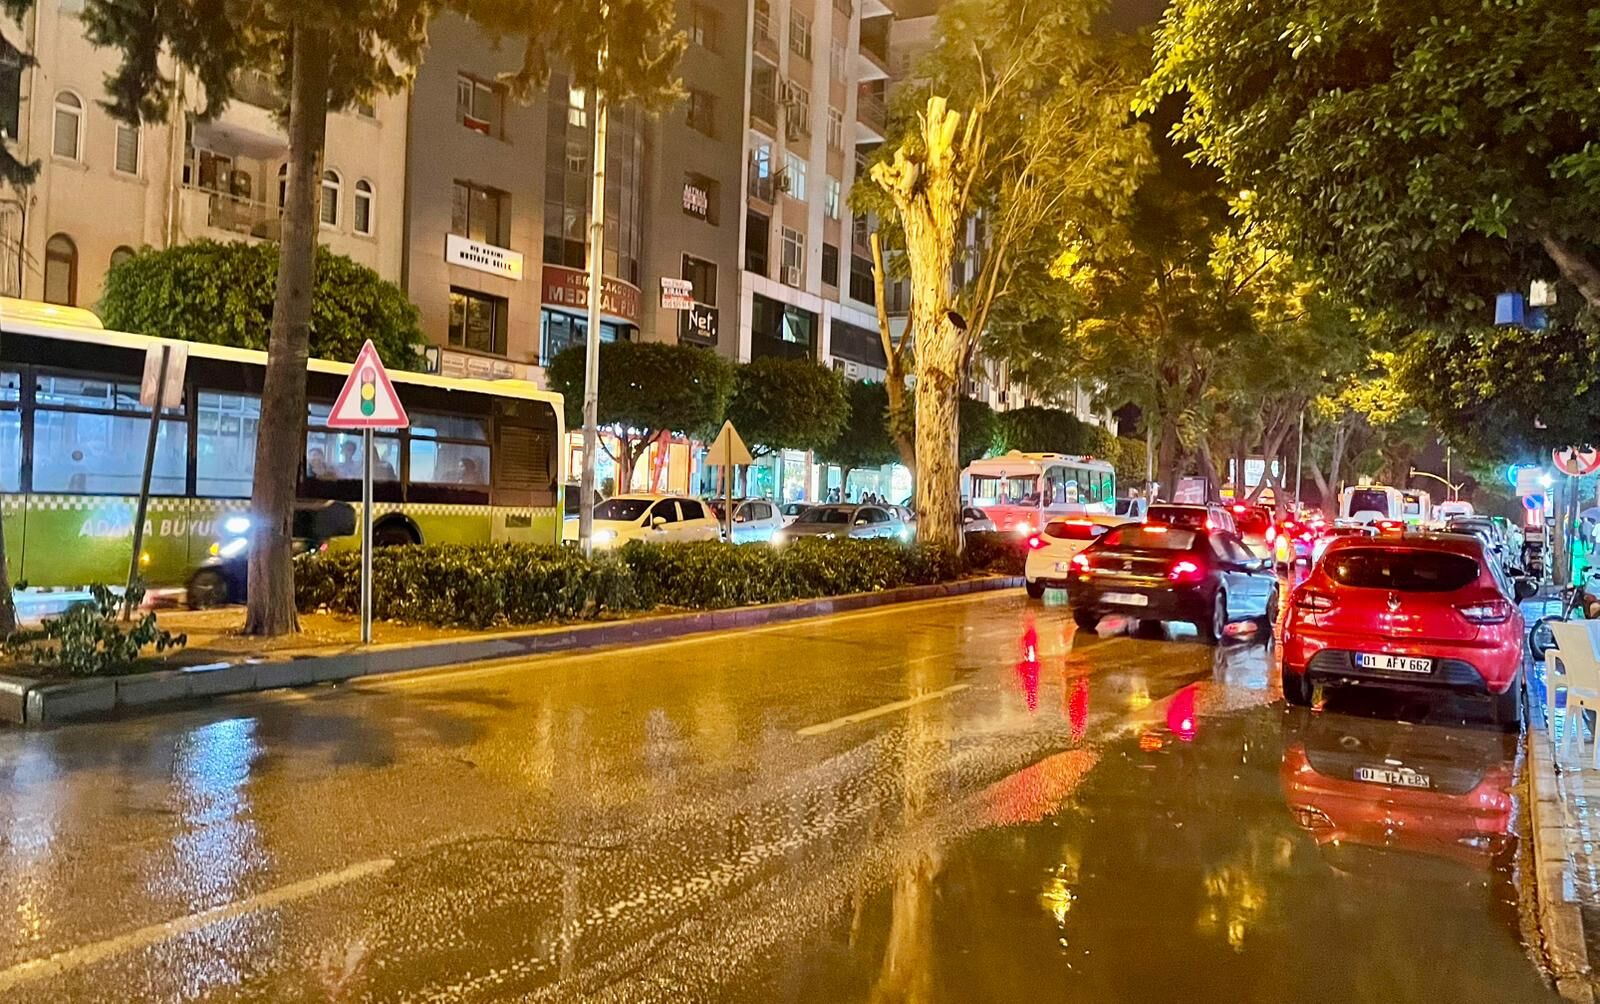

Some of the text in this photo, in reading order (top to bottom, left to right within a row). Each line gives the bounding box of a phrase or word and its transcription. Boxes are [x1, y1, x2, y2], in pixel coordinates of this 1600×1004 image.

[567, 273, 604, 290] KEM
[549, 286, 618, 313] MEDAL
[1363, 655, 1430, 672] 01 AFV 662
